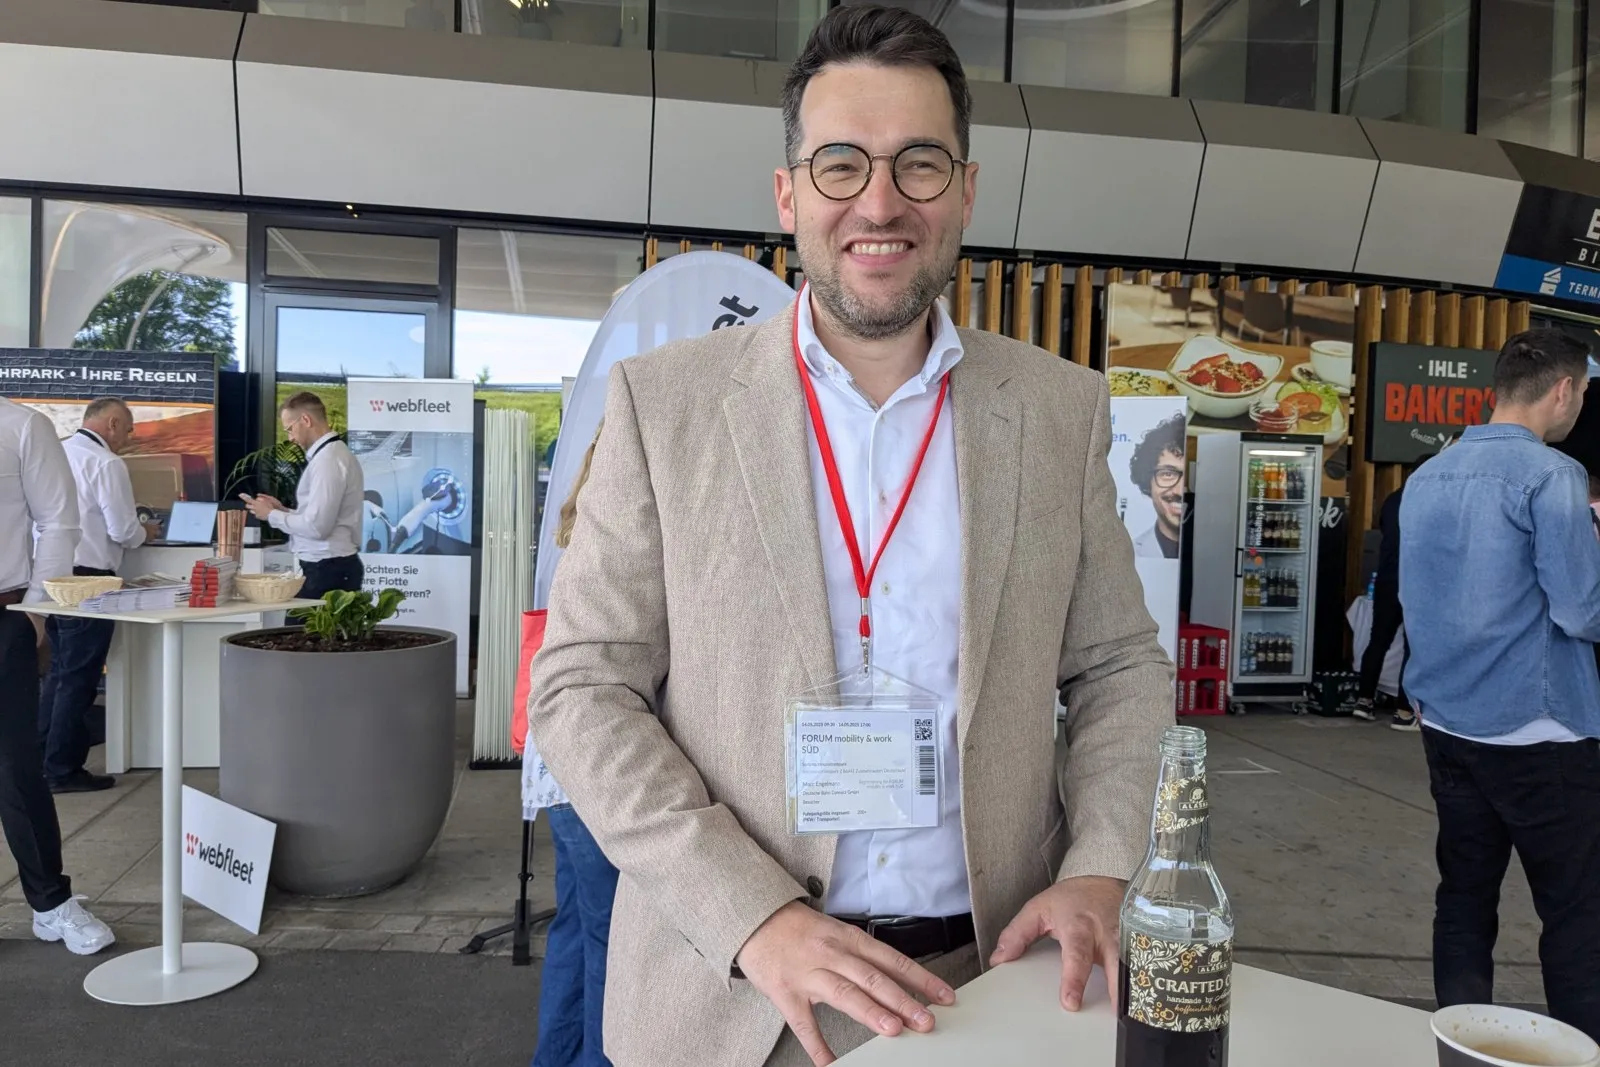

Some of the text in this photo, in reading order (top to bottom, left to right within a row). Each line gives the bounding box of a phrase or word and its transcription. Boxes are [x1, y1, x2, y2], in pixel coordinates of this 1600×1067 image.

[1568, 282, 1600, 299] TERM
[0, 368, 65, 379] HRPARK
[1428, 360, 1468, 378] IHLE
[386, 398, 451, 413] webfleet
[363, 564, 419, 575] öchten Sie
[378, 576, 409, 586] Flotte
[802, 734, 892, 744] FORUM mobility & work
[801, 744, 820, 754] SÜD
[199, 842, 254, 885] webfleet
[1154, 977, 1223, 994] CRAFTED
[1166, 995, 1213, 1004] handmade by
